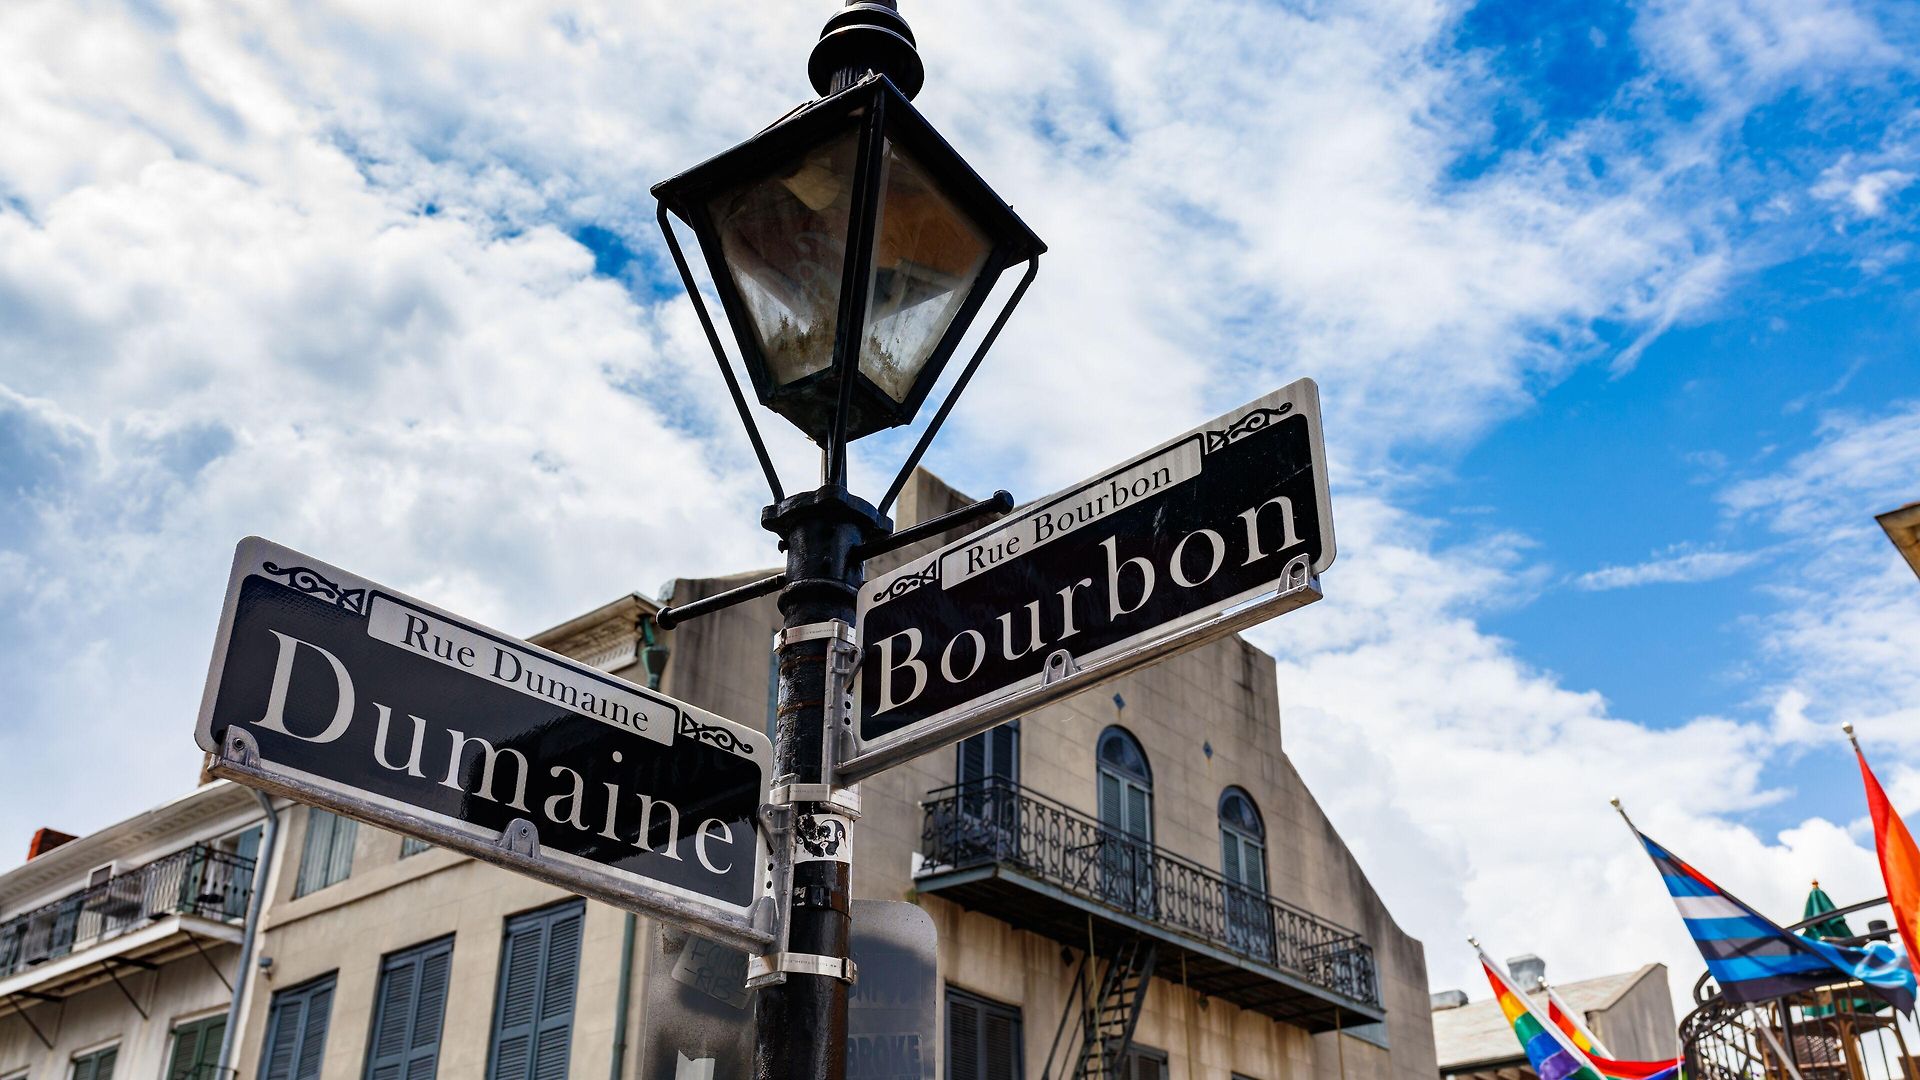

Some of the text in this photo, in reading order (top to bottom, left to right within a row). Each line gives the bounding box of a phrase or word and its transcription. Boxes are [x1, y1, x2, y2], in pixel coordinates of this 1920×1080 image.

[870, 496, 1305, 718] Bourbon
[965, 467, 1173, 576] Rue Bourbon
[249, 629, 734, 875] Dumaine
[400, 612, 649, 732] Rue Dumaine
